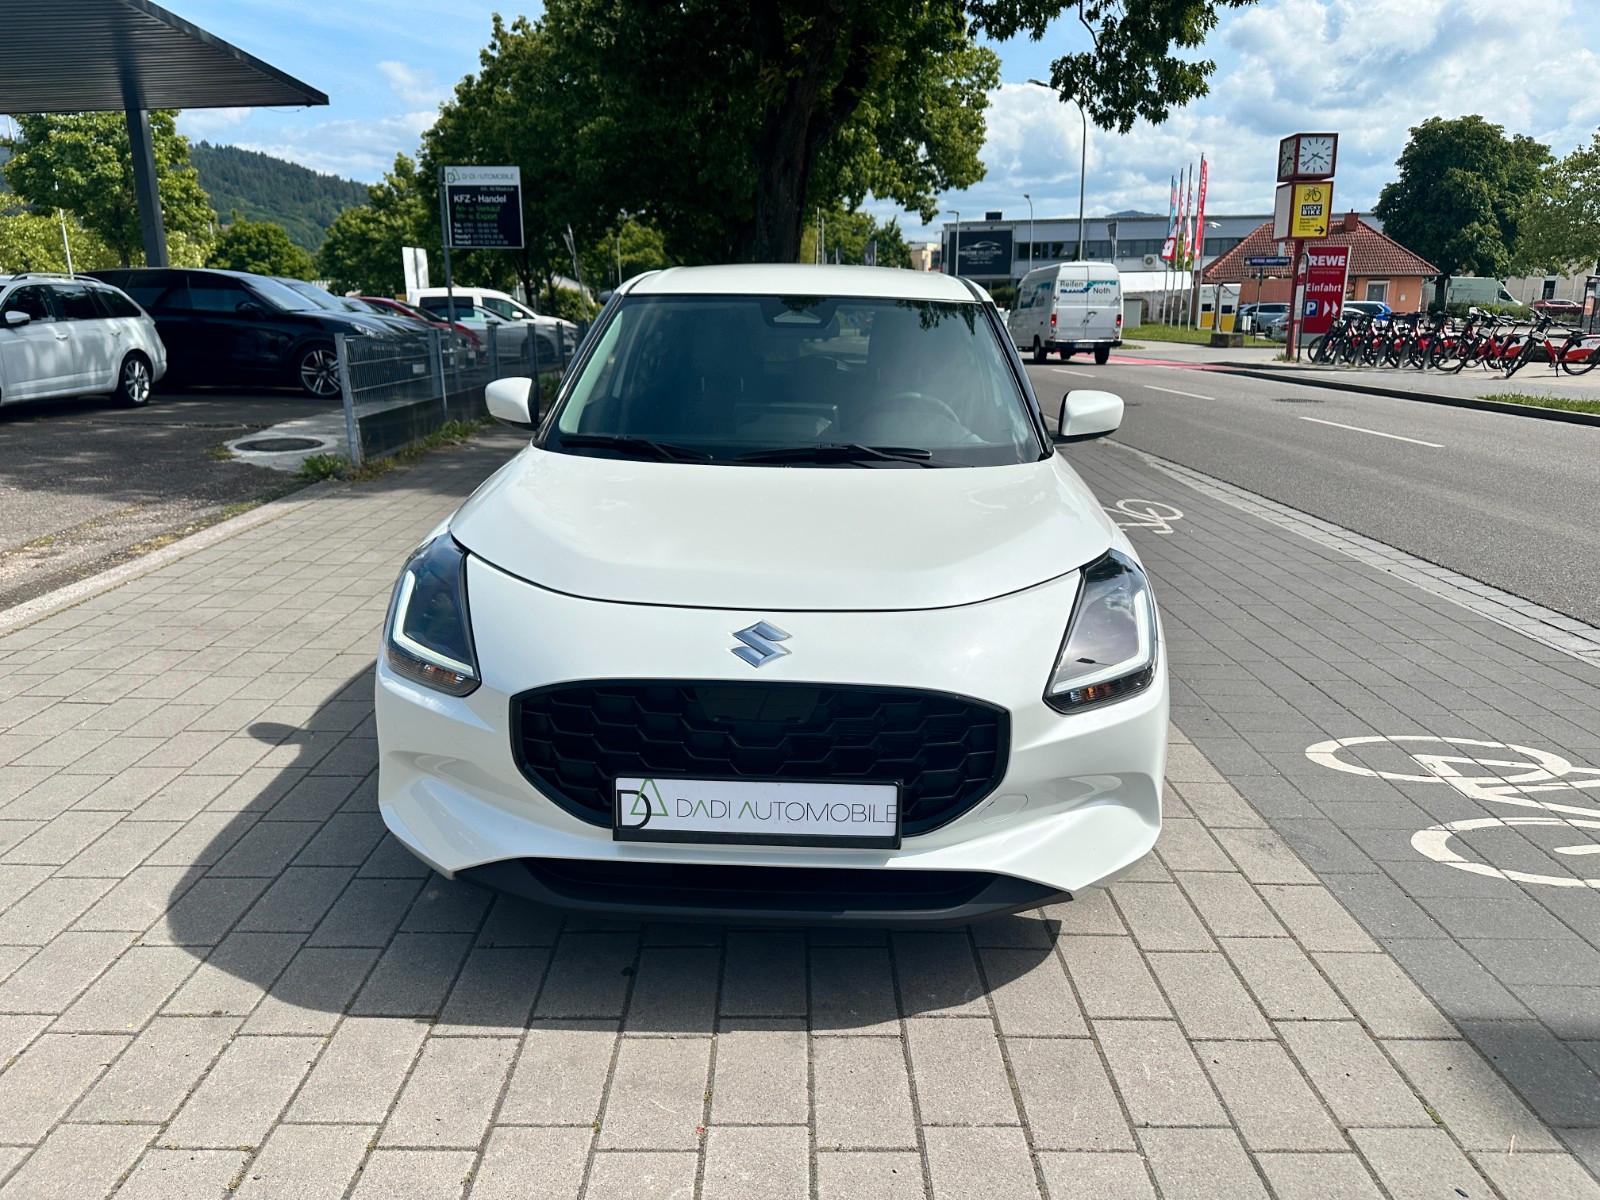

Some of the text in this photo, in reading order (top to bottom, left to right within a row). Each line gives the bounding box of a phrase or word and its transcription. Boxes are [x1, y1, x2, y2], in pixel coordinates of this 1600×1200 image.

[454, 194, 471, 203] KFZ
[478, 194, 507, 203] Handel
[1309, 255, 1346, 267] REWE
[1306, 283, 1342, 292] Einfahrt
[1306, 301, 1317, 315] P
[676, 798, 731, 819] DADI
[738, 801, 898, 824] AUTOMOBILE
